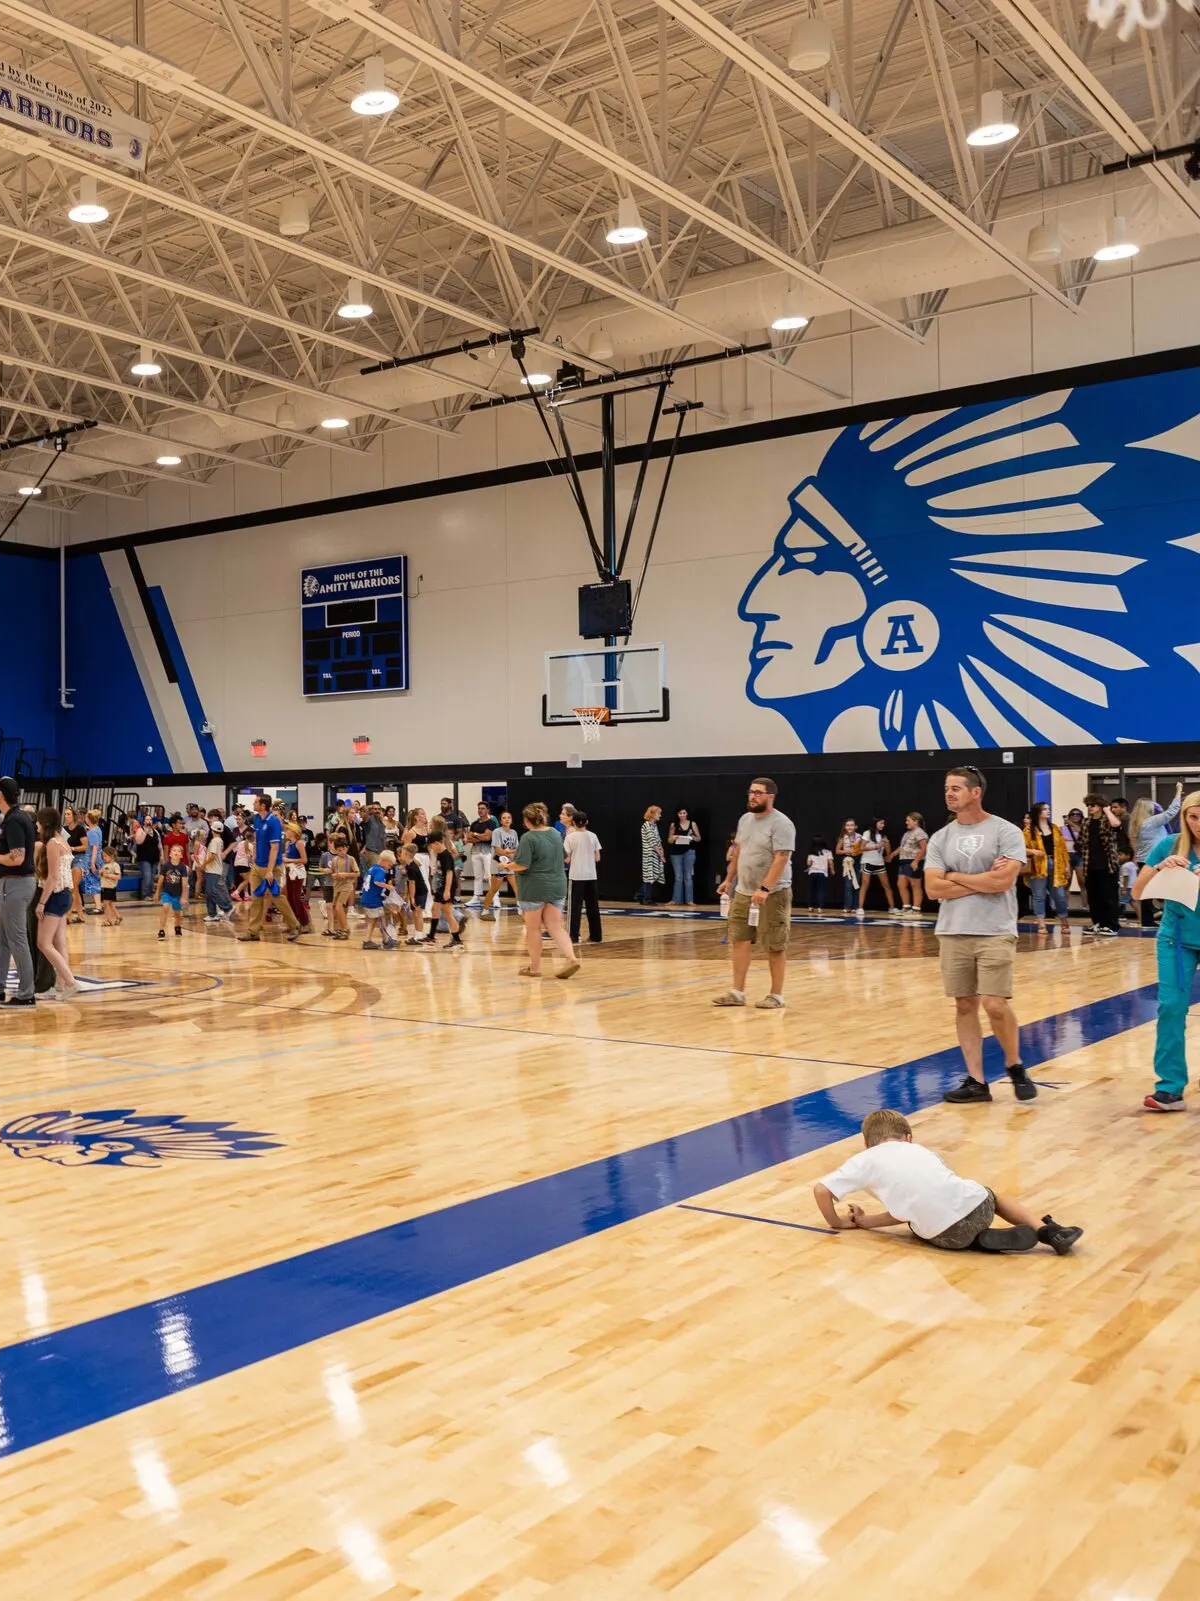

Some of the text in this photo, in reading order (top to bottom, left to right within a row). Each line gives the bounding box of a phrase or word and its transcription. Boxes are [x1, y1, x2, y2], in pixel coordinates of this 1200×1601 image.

[8, 65, 22, 78] by
[26, 71, 42, 87] the
[45, 80, 73, 100] Class
[76, 96, 87, 105] of
[89, 99, 113, 117] 2022
[56, 95, 73, 106] future
[333, 568, 383, 582] HOME OF THE
[319, 574, 401, 594] AMITY WARRIORS
[342, 630, 360, 639] PERIOD
[880, 614, 924, 655] A
